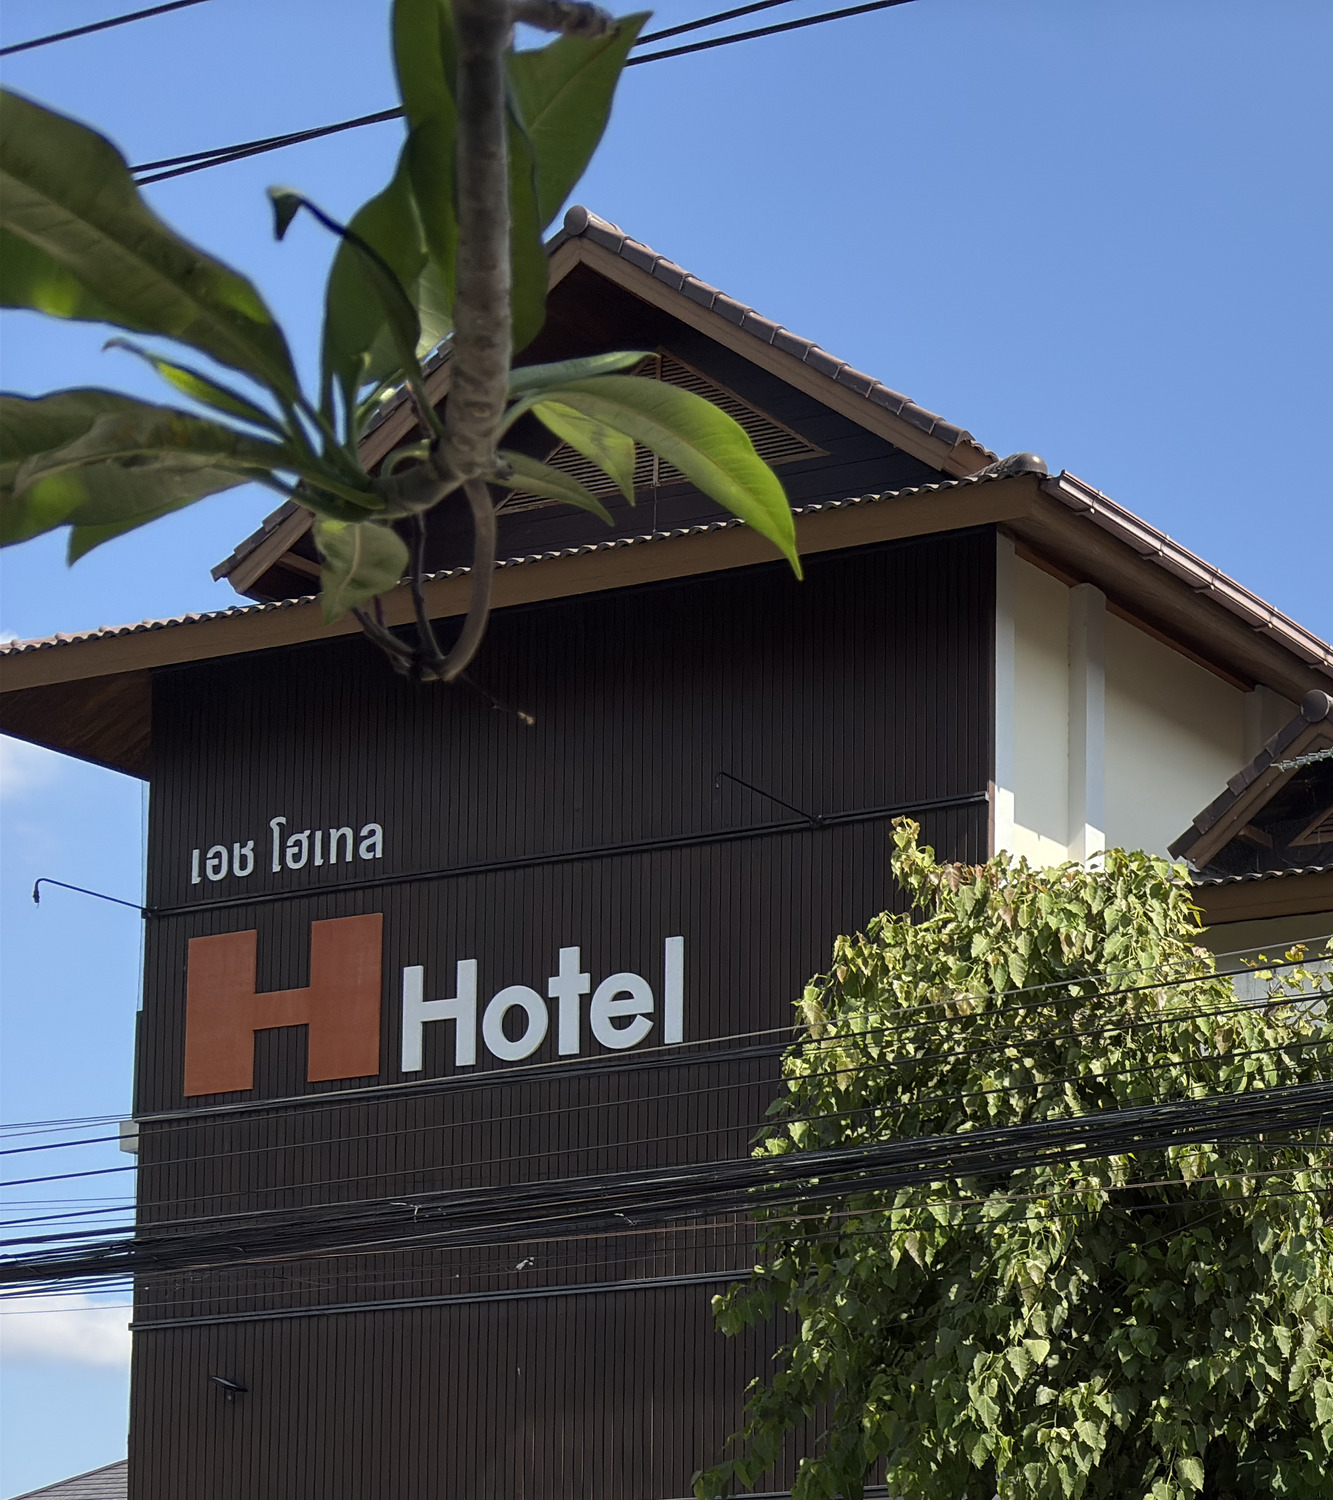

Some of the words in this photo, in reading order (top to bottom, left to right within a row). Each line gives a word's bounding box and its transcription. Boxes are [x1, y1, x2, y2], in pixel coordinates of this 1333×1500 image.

[191, 839, 254, 884] เอช
[269, 816, 384, 872] โฮเทล
[183, 912, 383, 1097] H
[401, 936, 685, 1072] Hotel
